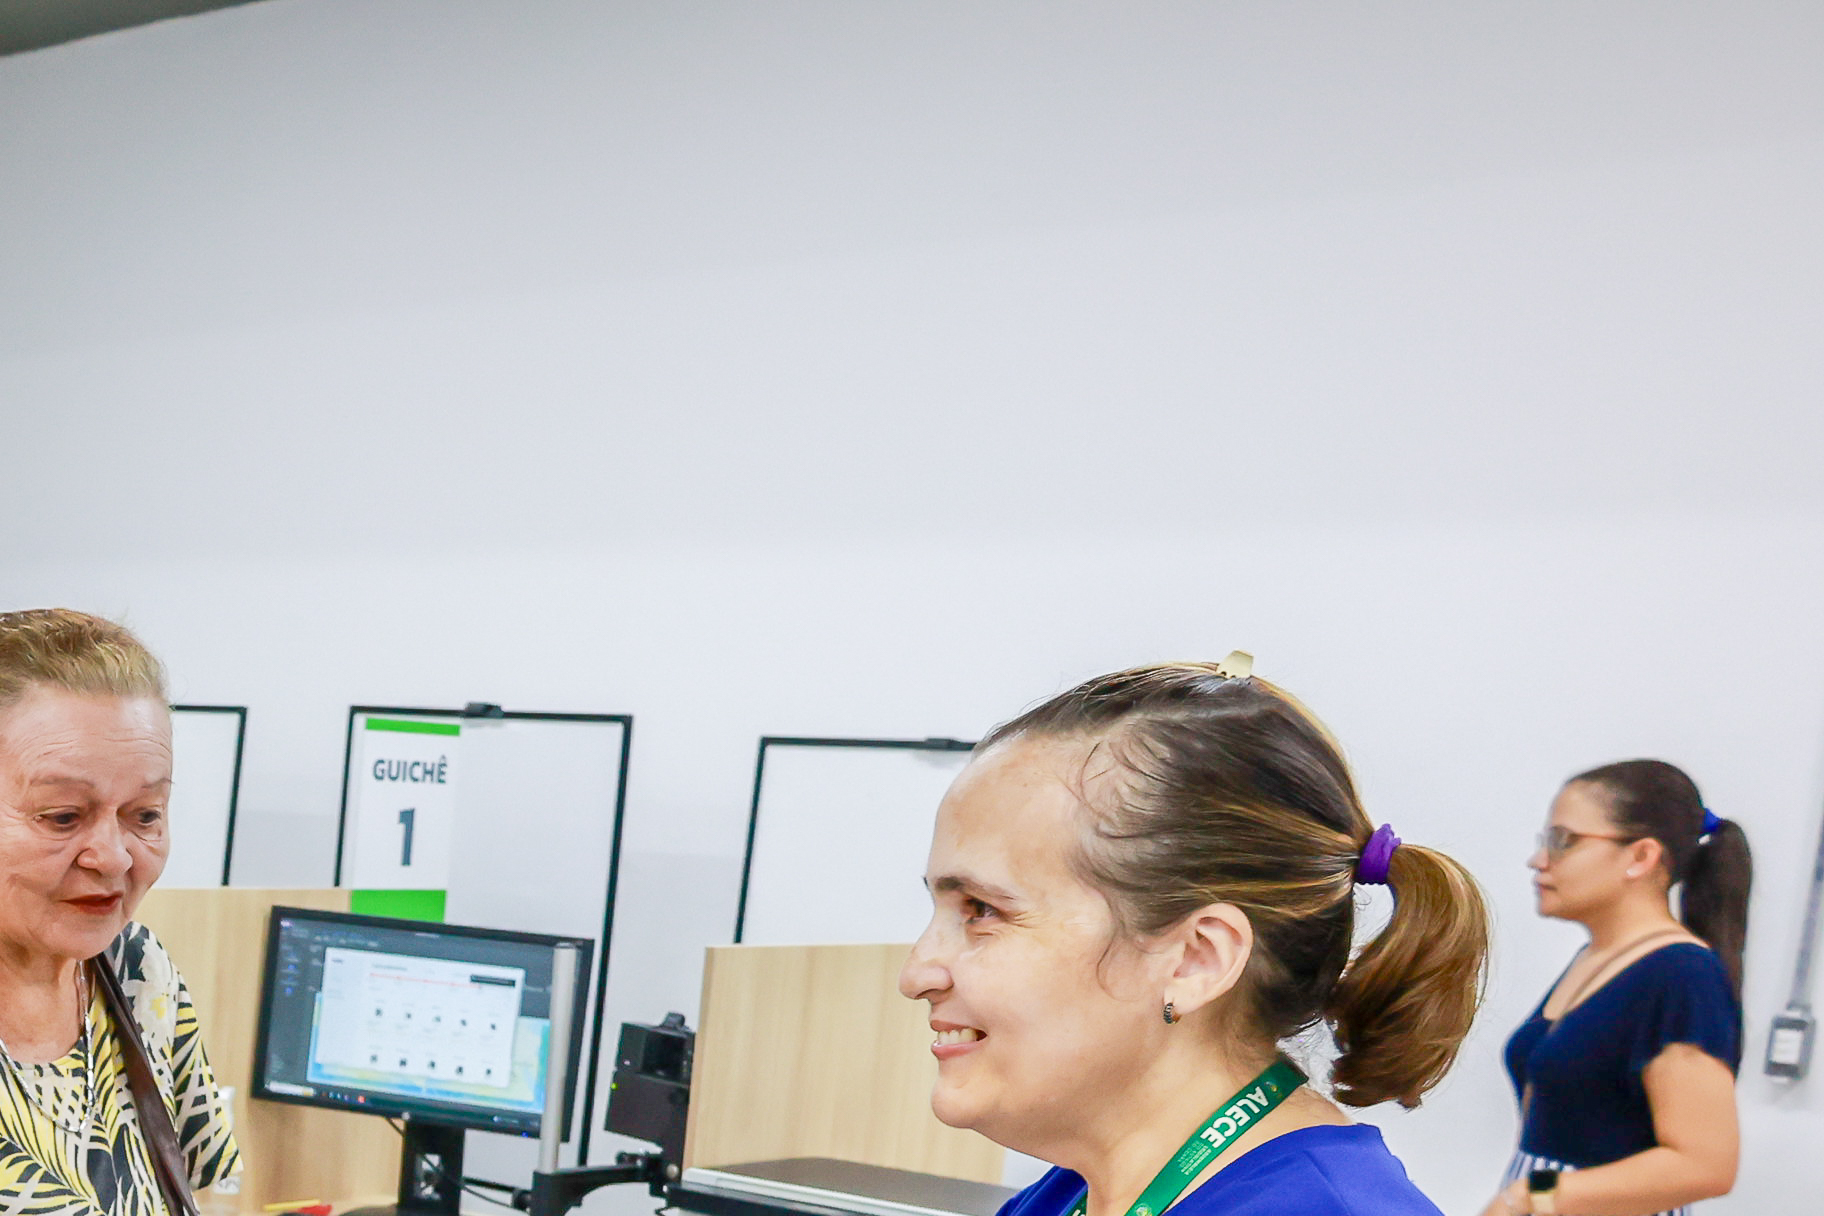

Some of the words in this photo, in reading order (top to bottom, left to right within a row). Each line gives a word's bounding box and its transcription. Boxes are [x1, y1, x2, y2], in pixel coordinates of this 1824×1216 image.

[373, 755, 448, 784] GUICHÊ
[398, 807, 415, 867] 1
[1199, 1086, 1269, 1149] ALECE
